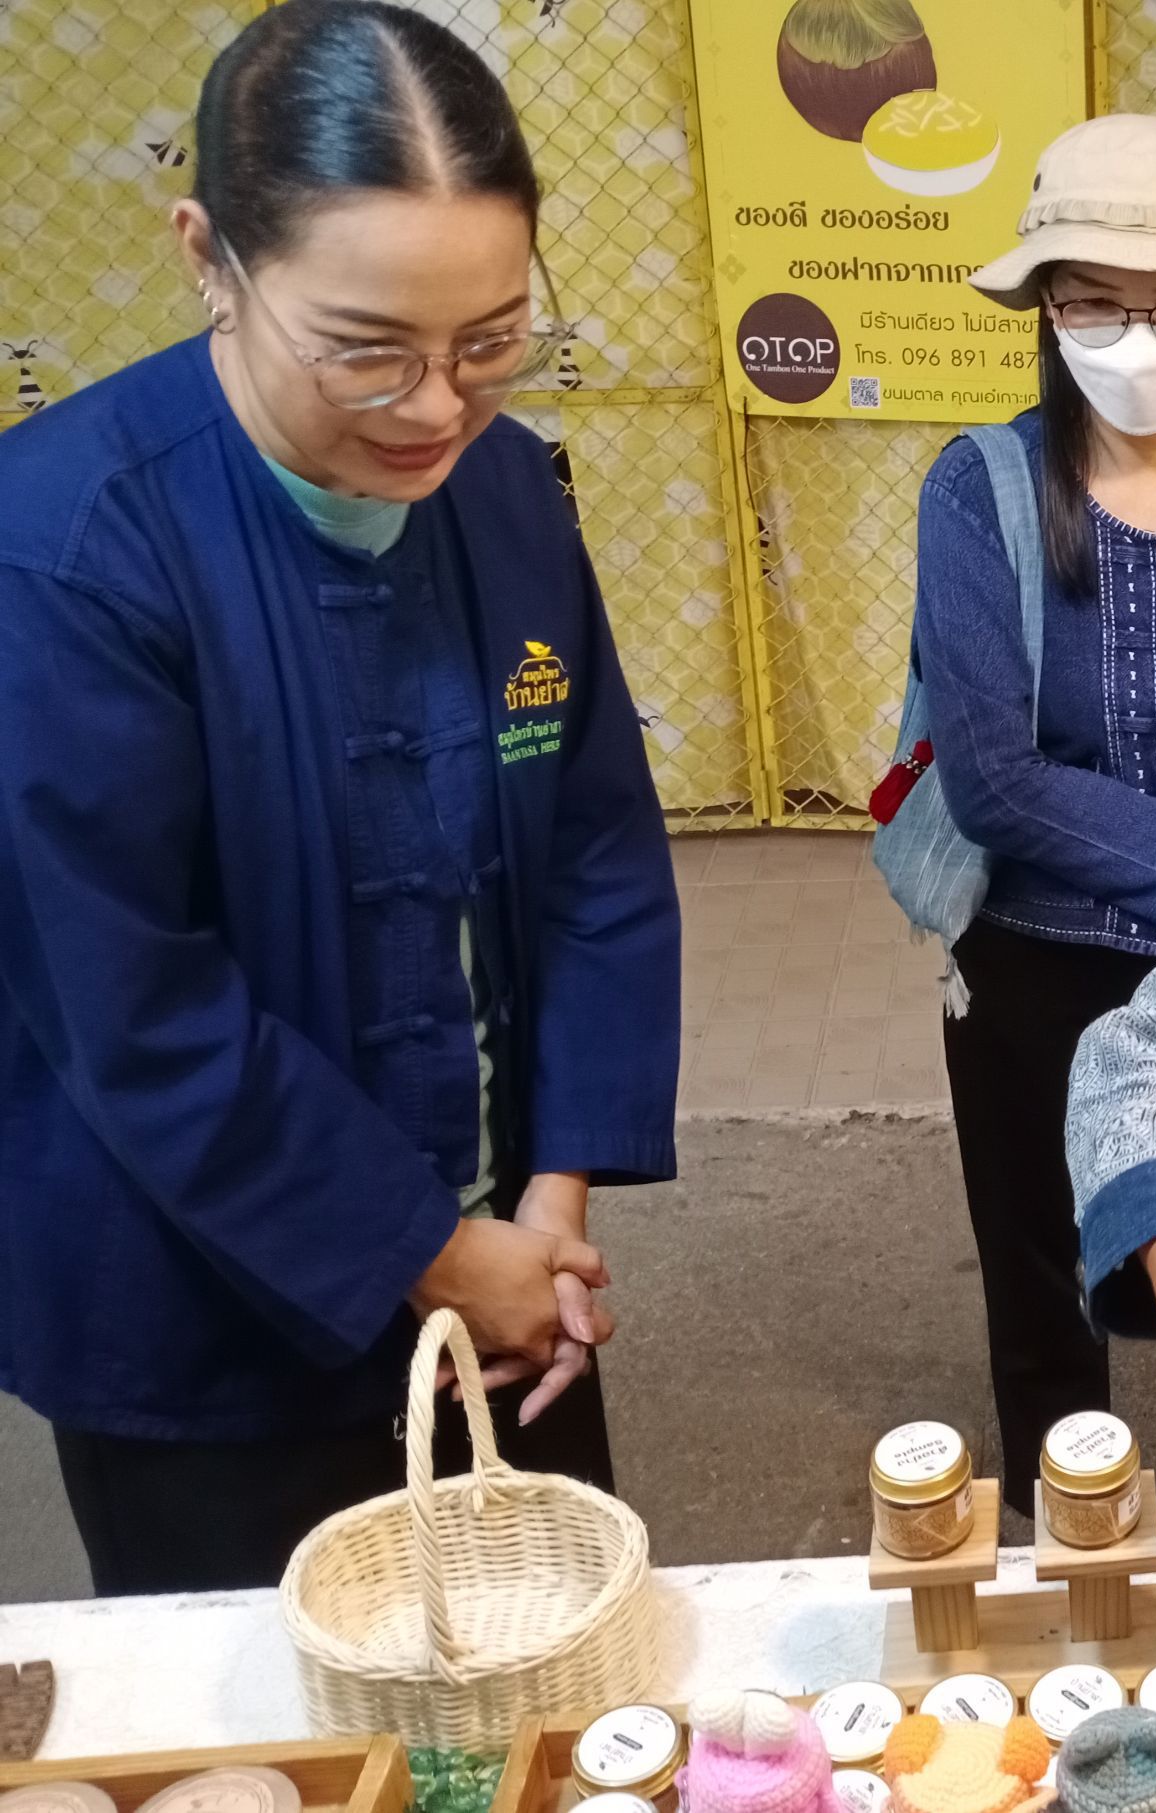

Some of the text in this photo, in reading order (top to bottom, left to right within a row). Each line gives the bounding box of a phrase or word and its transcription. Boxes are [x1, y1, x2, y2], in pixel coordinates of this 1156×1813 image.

[735, 201, 949, 231] ของดี ของอร่อย
[788, 256, 985, 283] ของฝากจากเก
[859, 311, 955, 331] มีร้านเดียว
[742, 336, 834, 364] OTOP
[855, 344, 892, 365] โทร.
[902, 347, 941, 366] 096
[951, 349, 986, 368] 891
[745, 363, 835, 374] One Tambon One Product
[883, 388, 944, 402] ขนมตาล
